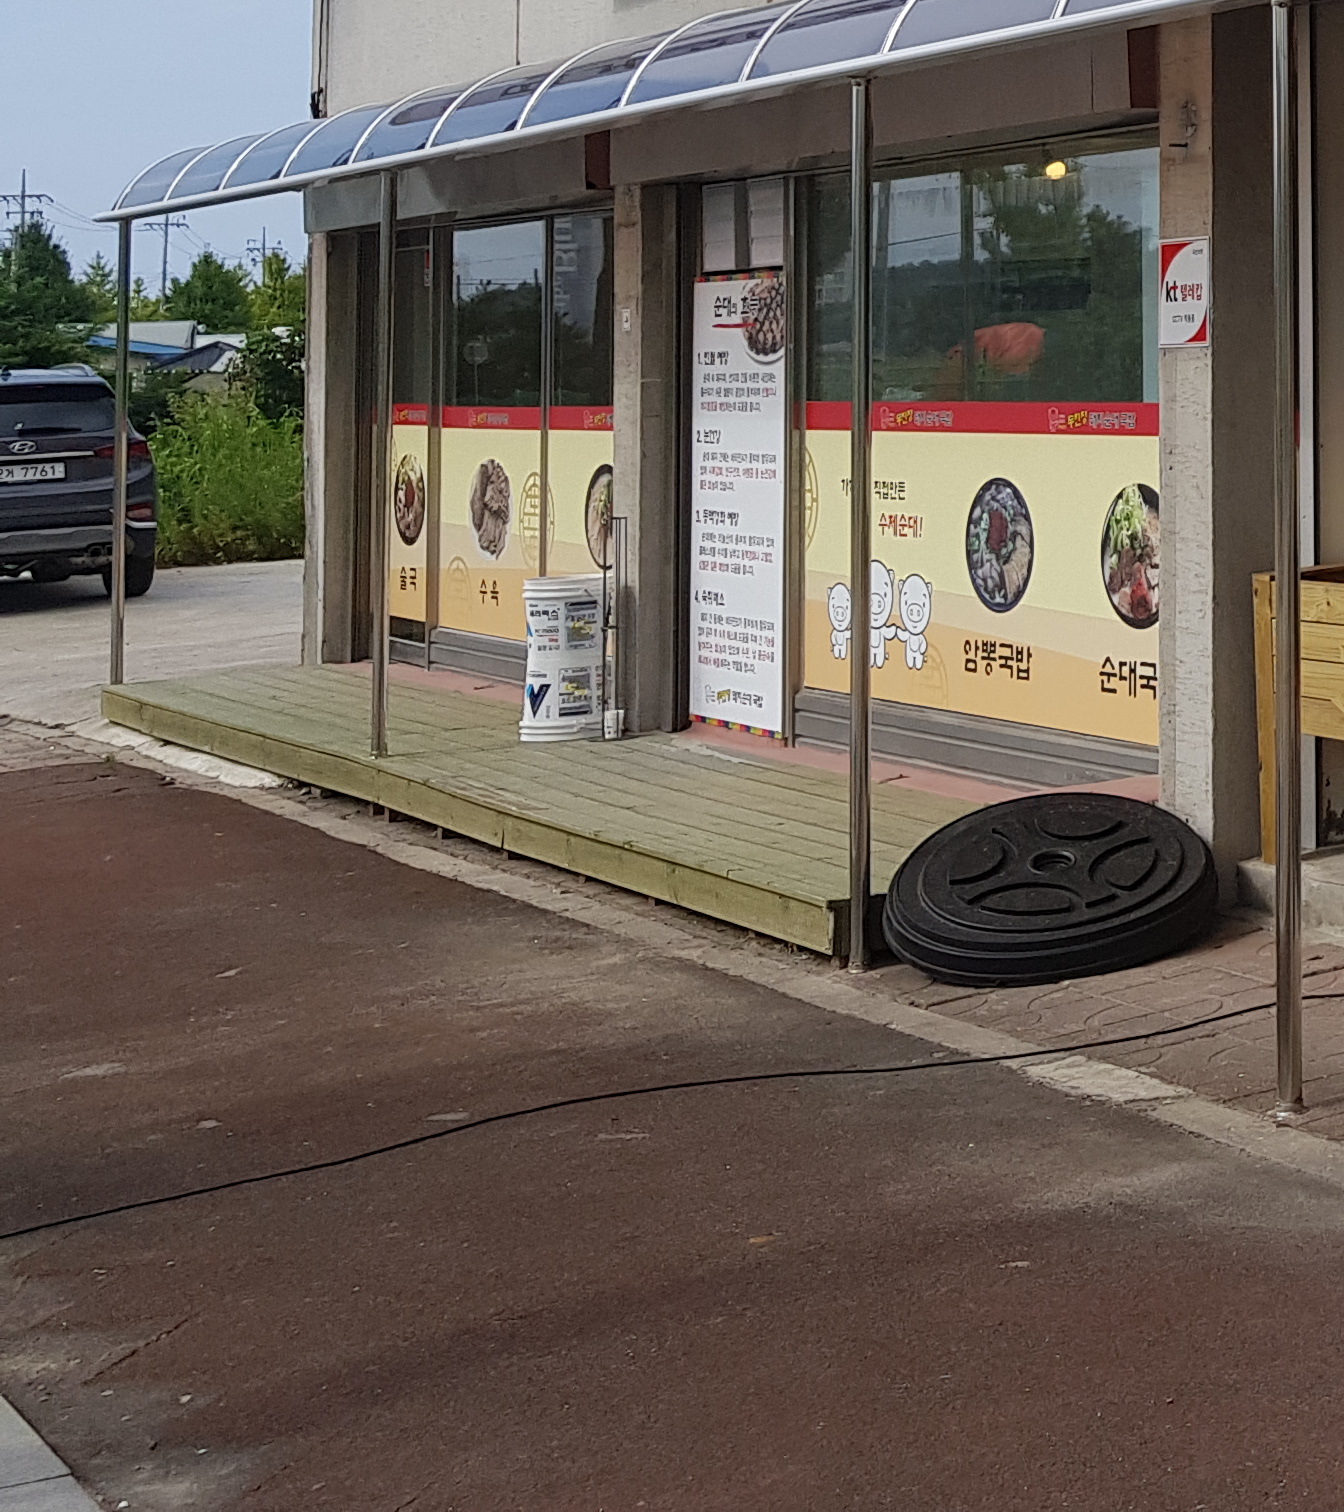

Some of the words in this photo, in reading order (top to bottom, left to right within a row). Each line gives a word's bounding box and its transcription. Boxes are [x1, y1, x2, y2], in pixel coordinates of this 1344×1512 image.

[1166, 280, 1178, 302] kt
[21, 465, 56, 478] 7761
[874, 481, 906, 500] 직접만든
[879, 513, 923, 538] 수제순대!
[964, 639, 1032, 681] 암뽕국밥
